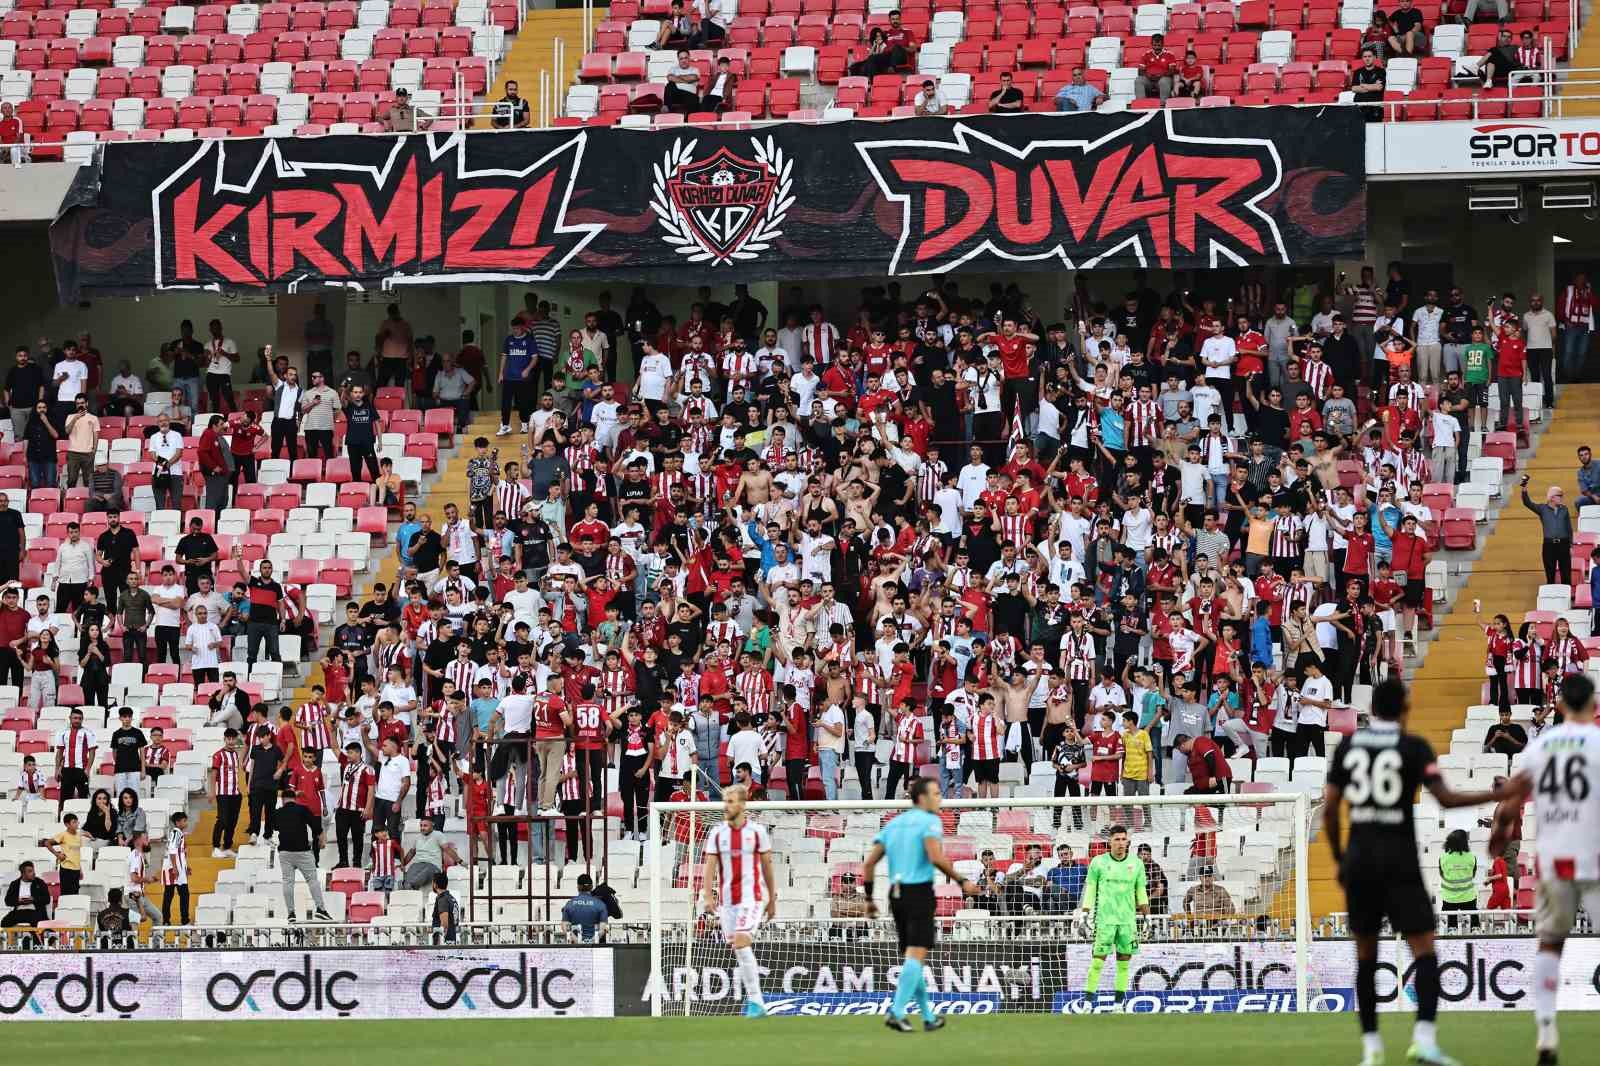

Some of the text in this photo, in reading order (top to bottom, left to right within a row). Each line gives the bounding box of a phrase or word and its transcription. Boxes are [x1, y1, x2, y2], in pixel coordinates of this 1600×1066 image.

[173, 143, 1265, 287] KIRMIZI DUVAR
[695, 207, 751, 242] KD
[576, 706, 600, 729] 58
[1342, 747, 1404, 807] 36
[1537, 754, 1590, 803] 46
